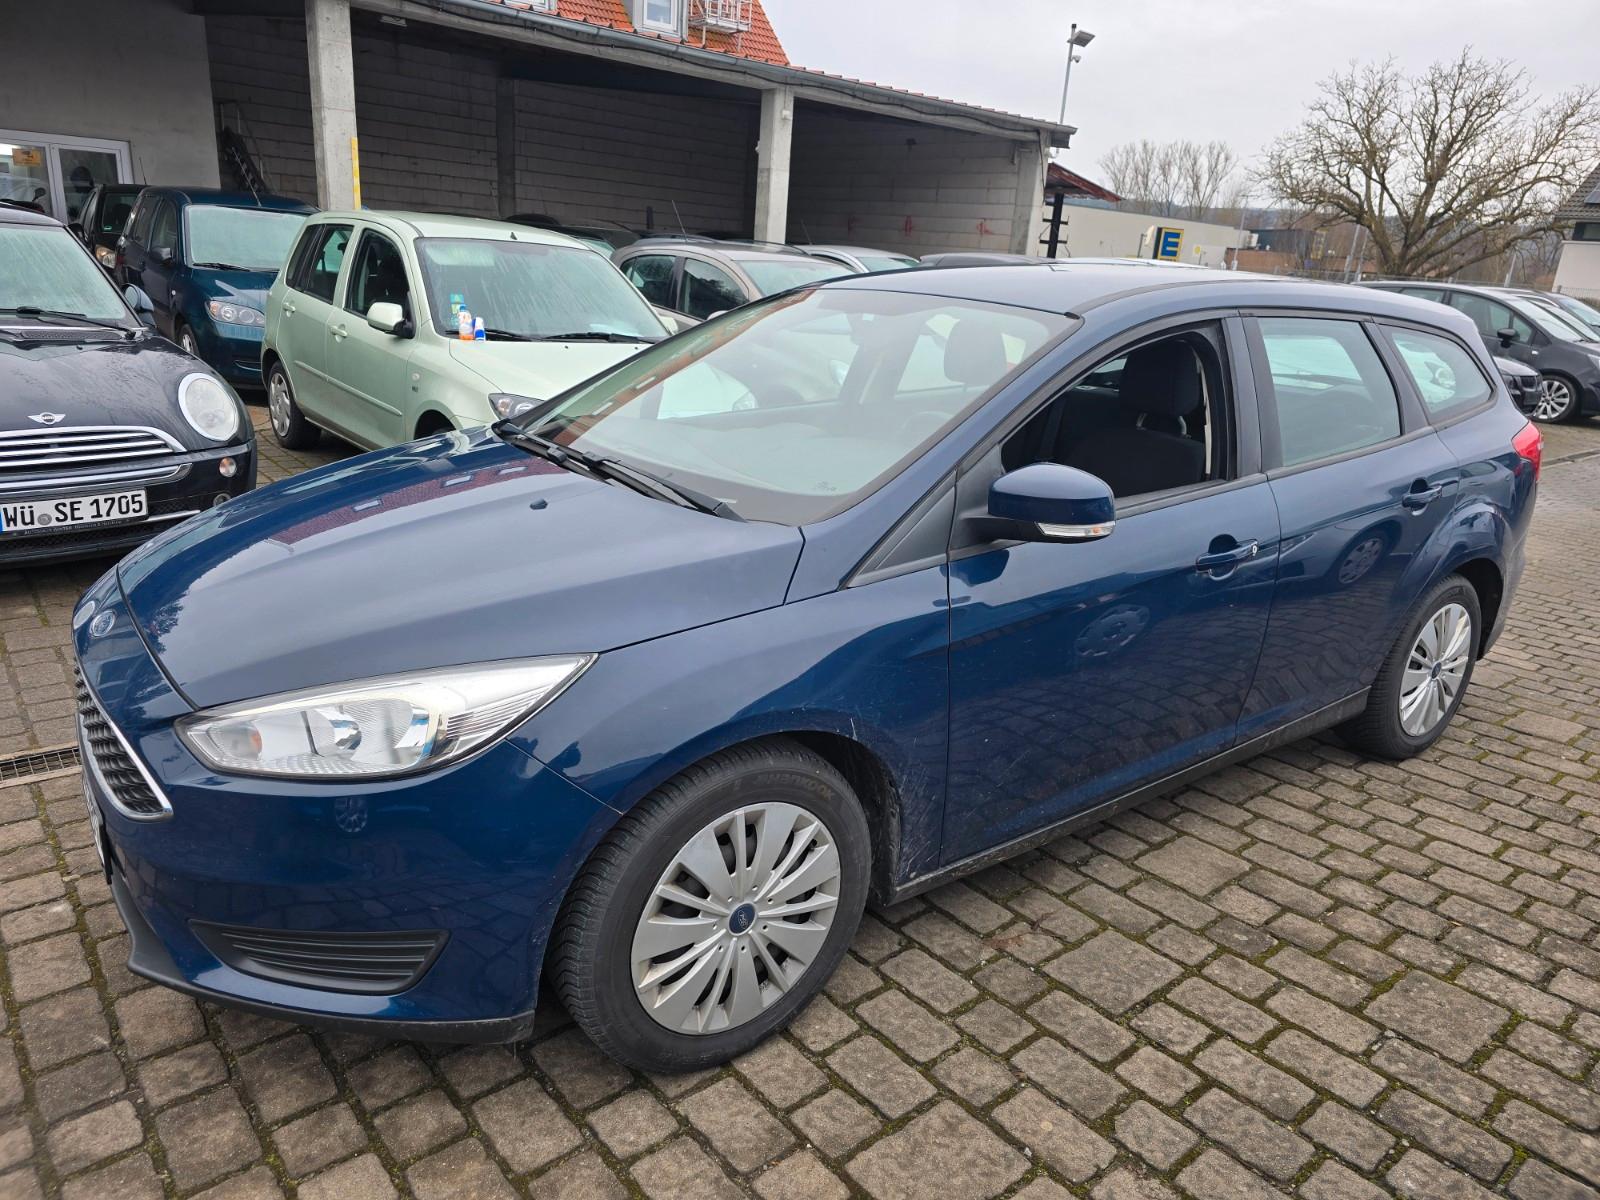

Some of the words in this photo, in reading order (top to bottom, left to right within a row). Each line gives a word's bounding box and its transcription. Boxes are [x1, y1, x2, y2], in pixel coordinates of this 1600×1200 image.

[1161, 231, 1181, 257] E
[3, 505, 35, 528] WÜ
[54, 500, 84, 523] SE
[90, 493, 143, 519] 1705
